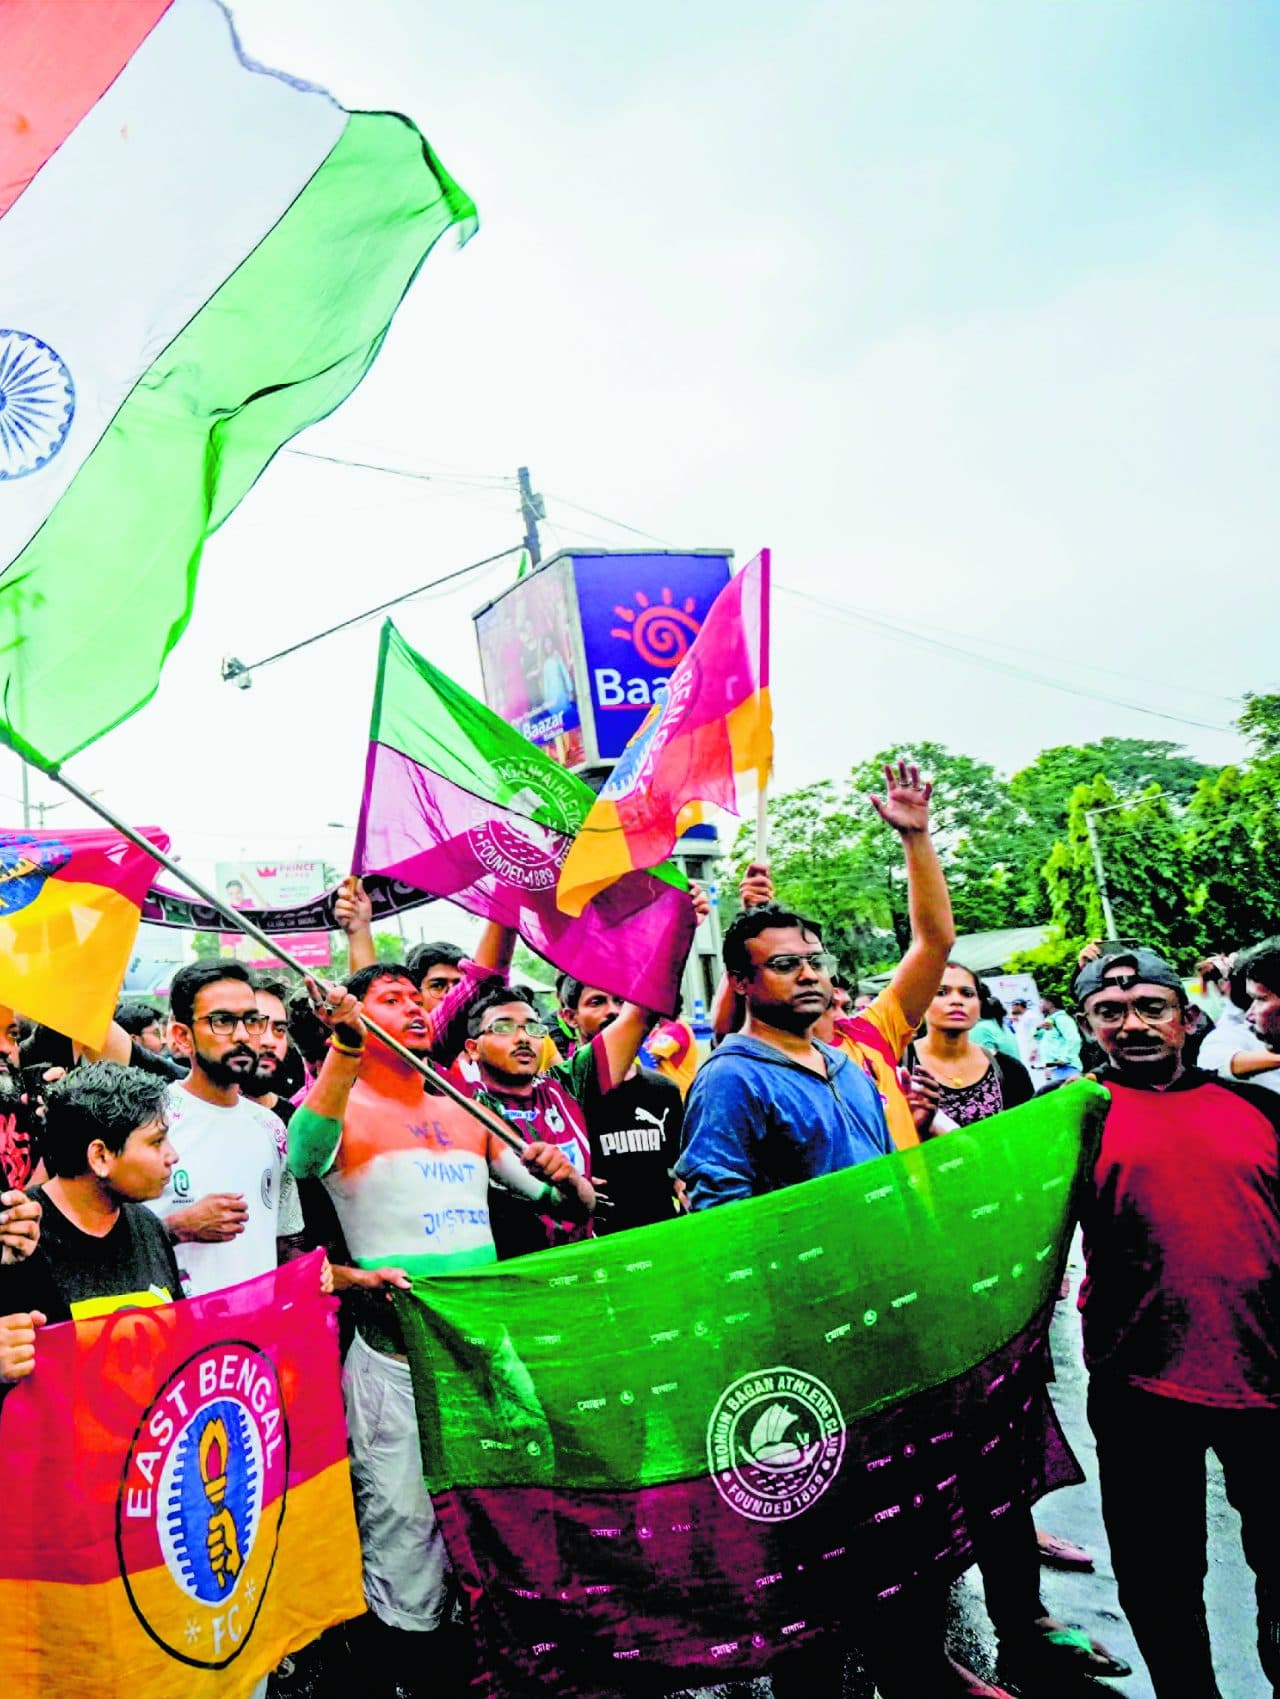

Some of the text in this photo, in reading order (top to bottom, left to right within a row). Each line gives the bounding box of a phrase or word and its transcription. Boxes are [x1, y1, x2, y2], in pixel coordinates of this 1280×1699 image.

[594, 668, 669, 706] Baa
[279, 863, 315, 871] PRINCE
[475, 840, 525, 884] FOUNDED
[599, 1128, 661, 1156] PUMA
[414, 1160, 476, 1185] WANT
[422, 1206, 490, 1236] JUSTIC
[126, 1354, 282, 1519] EAST BENGAL
[714, 1375, 840, 1471] MOHUN BAGAN ATHLETIC CLUB
[727, 1483, 792, 1515] FOUNDED
[211, 1604, 243, 1655] FC
